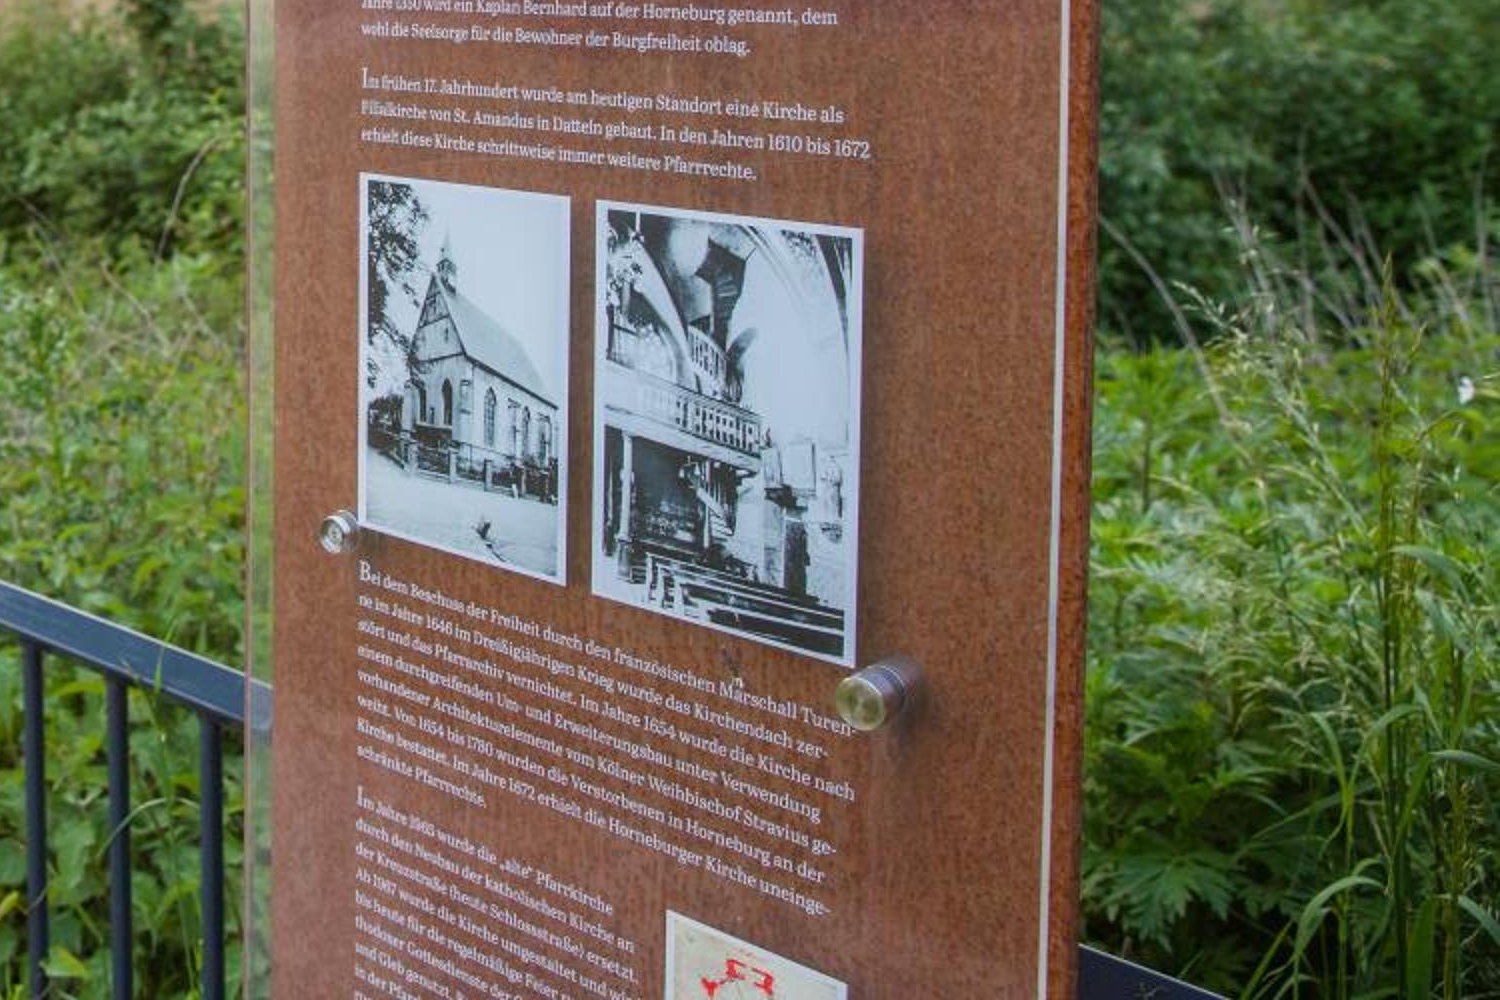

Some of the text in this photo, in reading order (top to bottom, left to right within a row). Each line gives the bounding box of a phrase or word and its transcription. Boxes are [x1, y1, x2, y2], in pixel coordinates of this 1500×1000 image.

[362, 23, 389, 37] wohl
[390, 23, 410, 38] die
[471, 26, 491, 42] für
[493, 27, 512, 43] die
[515, 28, 582, 46] Bewohner
[584, 30, 610, 47] der
[612, 31, 702, 53] Burgfreiheit
[704, 35, 751, 57] oblag.
[523, 0, 587, 16] Bernhard
[590, 1, 612, 17] auf
[615, 1, 640, 18] der
[643, 2, 724, 25] Horneburg
[727, 6, 798, 26] genannt,
[801, 7, 838, 24] dem
[382, 76, 421, 93] frühen
[439, 80, 518, 100] Jahrhundert
[522, 87, 564, 103] wurde
[567, 92, 588, 104] am
[590, 89, 653, 112] heutigen
[655, 94, 722, 114] Standort
[725, 99, 759, 117] eine
[762, 101, 817, 121] Kirche
[820, 105, 844, 123] als
[430, 109, 450, 121] von
[453, 107, 471, 123] St.
[473, 109, 534, 129] Amandus
[537, 114, 550, 130] in
[552, 115, 602, 135] Datteln
[605, 121, 656, 140] gebaut.
[659, 124, 675, 141] In
[679, 126, 708, 144] den
[710, 128, 764, 149] Jahren
[768, 133, 801, 152] 1610
[806, 136, 830, 155] bis
[835, 138, 871, 158] 1672
[402, 130, 432, 147] diese
[434, 133, 476, 151] Kirche
[558, 145, 604, 164] immer
[607, 152, 661, 170] weitere
[359, 560, 382, 587] Bei
[383, 575, 408, 595] dem
[466, 601, 488, 620] der
[491, 609, 540, 637] Freiheit
[543, 625, 582, 650] durch
[585, 638, 610, 659] den
[614, 647, 716, 693] französischen
[720, 681, 797, 719] Marschall
[802, 706, 856, 735] Turen-
[455, 624, 471, 641] im
[577, 663, 614, 692] Krieg
[617, 680, 663, 705] wurde
[665, 692, 690, 713] das
[694, 701, 792, 747] Kirchendach
[796, 738, 828, 756] zer-
[602, 700, 641, 726] Jahre
[643, 714, 676, 738] 1654
[679, 731, 727, 756] wurde
[730, 743, 754, 765] die
[757, 752, 812, 785] Kirche
[815, 776, 855, 800] nach
[566, 748, 836, 856] vom Kölner Weihbischof Stravius ge-
[571, 773, 825, 883] Verstorbenen in Horneburg an der
[676, 760, 718, 785] unter
[720, 772, 820, 826] Verwendung
[584, 804, 830, 912] die Horneburger Kirche uneinge-
